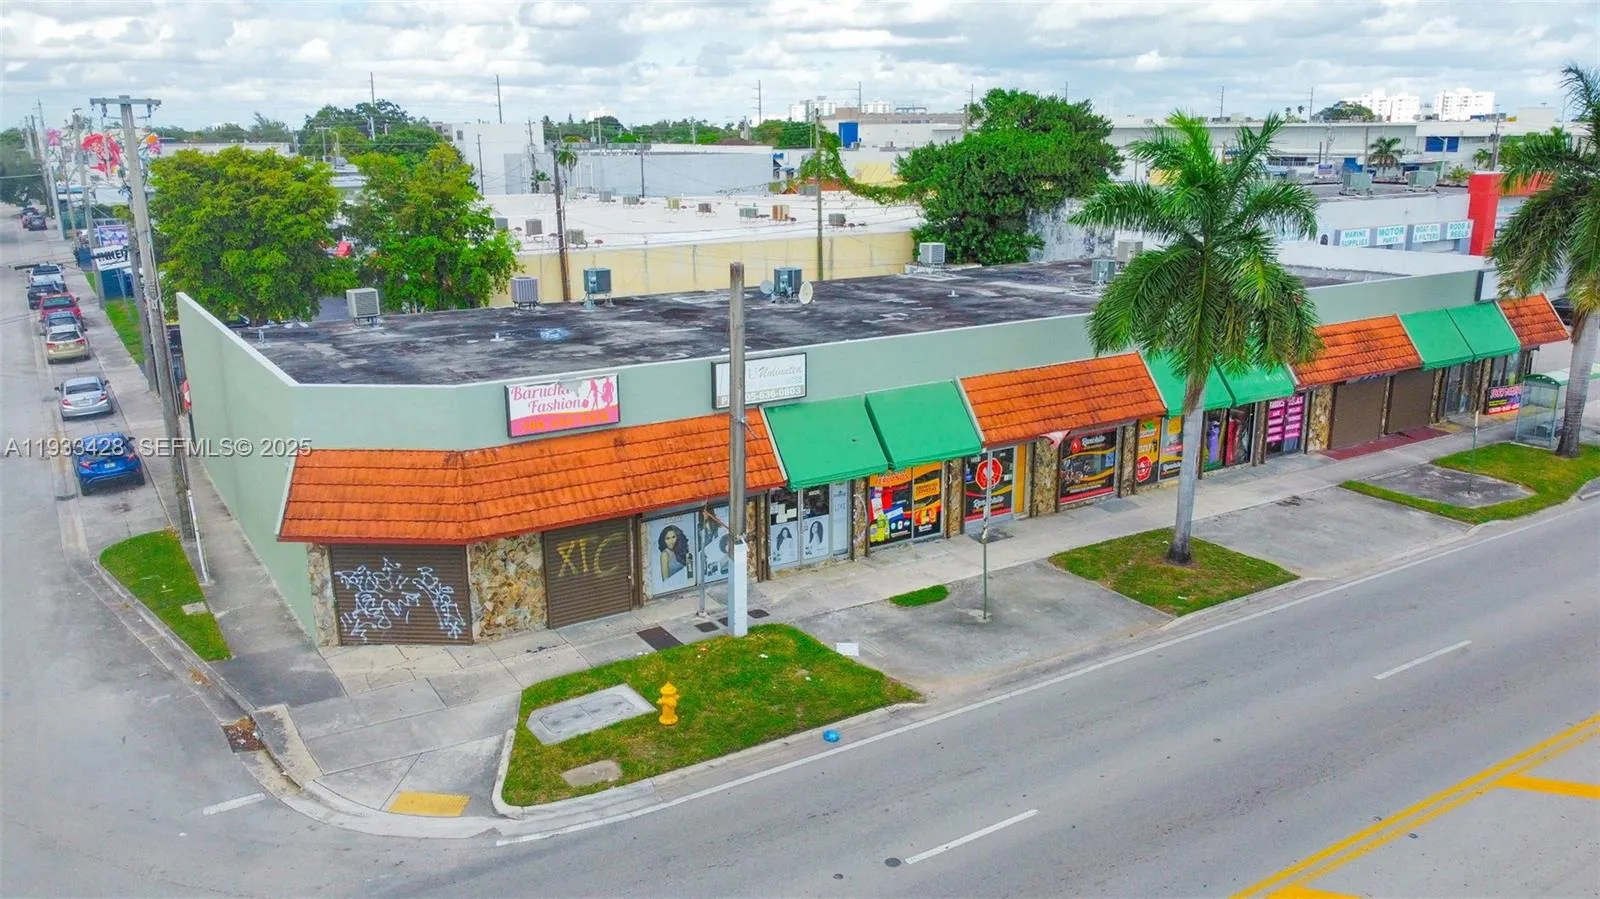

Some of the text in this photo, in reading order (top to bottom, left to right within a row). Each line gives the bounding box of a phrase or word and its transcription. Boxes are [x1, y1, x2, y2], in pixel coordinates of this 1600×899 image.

[1378, 226, 1405, 237] MOTOR
[1342, 238, 1368, 246] SUPPLIES
[528, 398, 581, 415] Fashion
